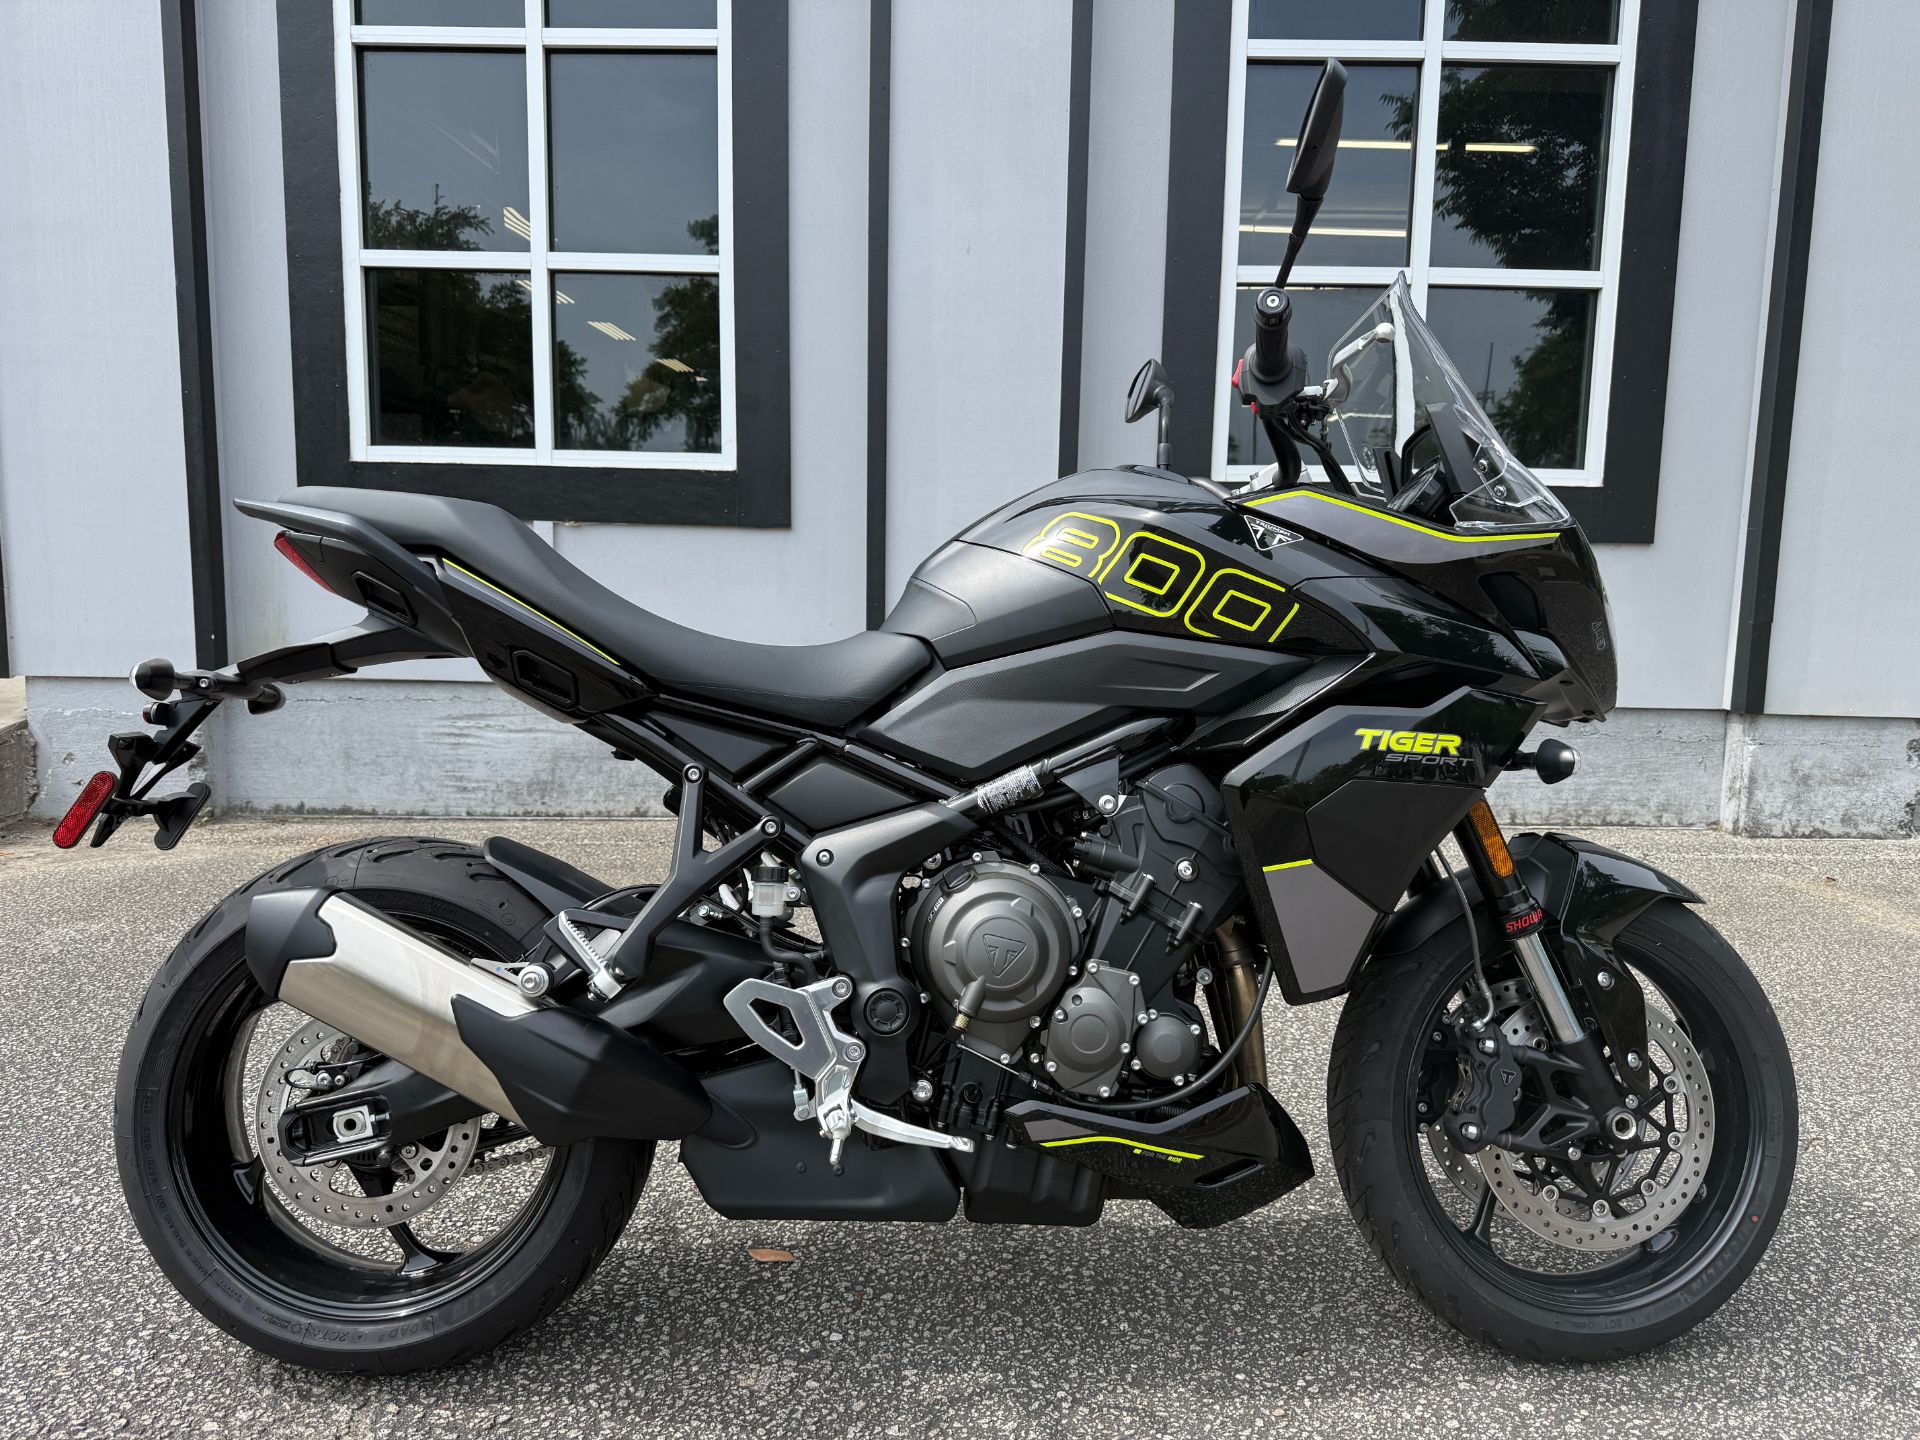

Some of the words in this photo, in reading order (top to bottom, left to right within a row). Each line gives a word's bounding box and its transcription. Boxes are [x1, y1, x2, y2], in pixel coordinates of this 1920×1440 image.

[1256, 519, 1291, 537] TRIUMPH
[1021, 511, 1300, 643] 800
[1354, 728, 1463, 756] TIGER
[1385, 753, 1475, 767] SPORT
[1505, 908, 1543, 933] SHOWA
